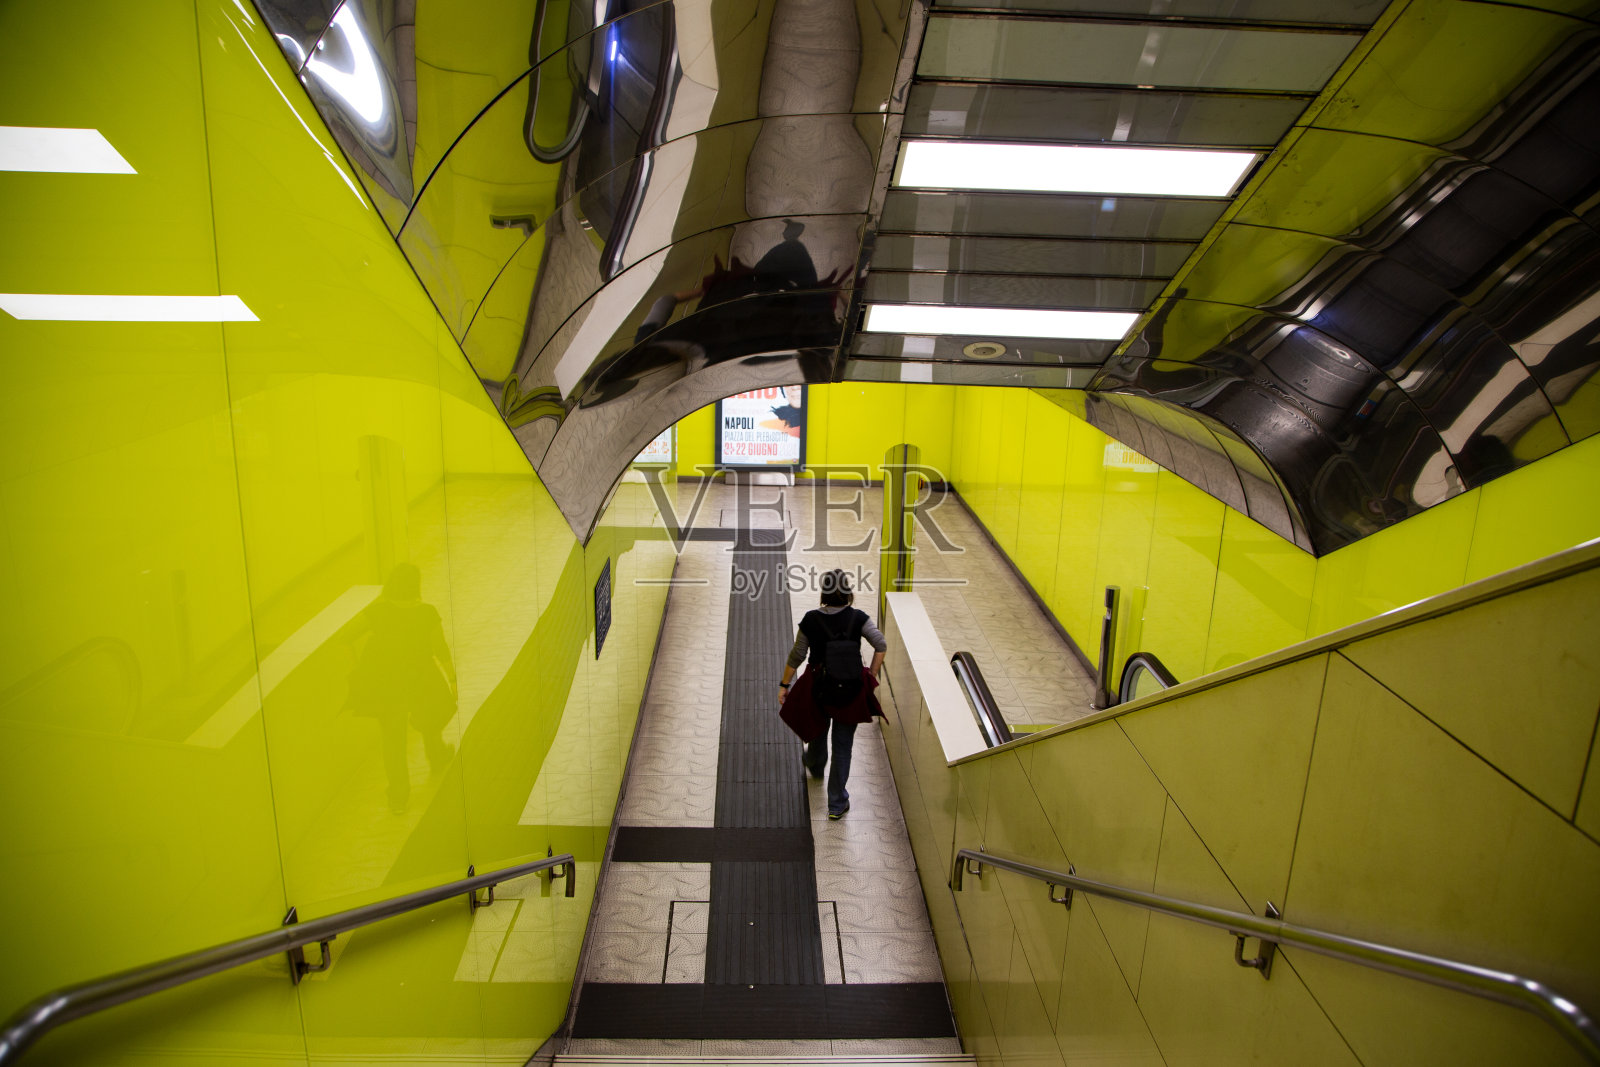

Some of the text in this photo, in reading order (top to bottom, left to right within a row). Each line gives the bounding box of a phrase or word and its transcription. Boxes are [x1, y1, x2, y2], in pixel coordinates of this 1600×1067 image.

[725, 417, 754, 429] NAPOLI
[725, 431, 788, 441] PIAZZA DEL PLEBISCITO
[748, 442, 777, 455] GIUGNO
